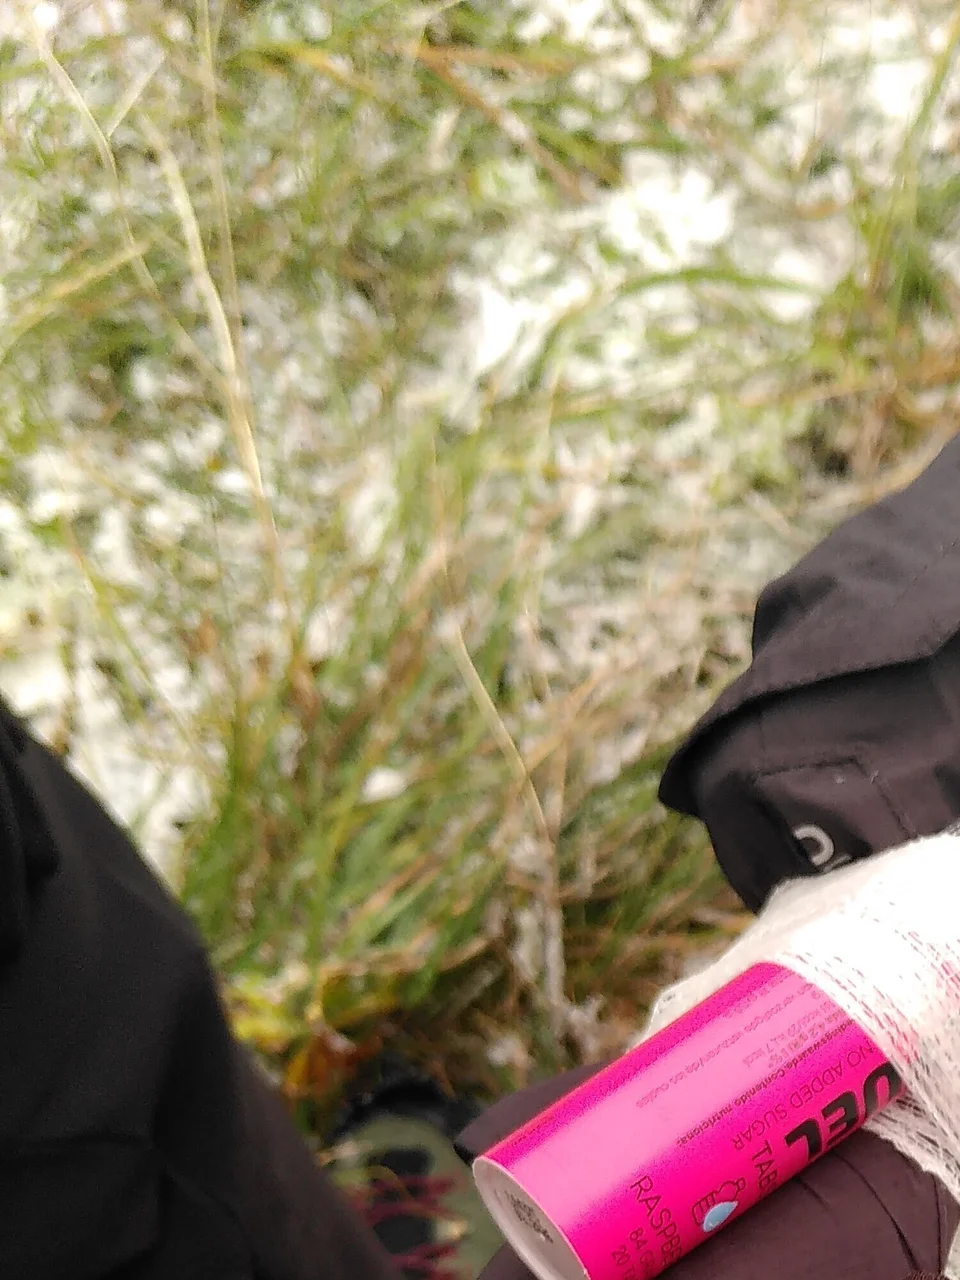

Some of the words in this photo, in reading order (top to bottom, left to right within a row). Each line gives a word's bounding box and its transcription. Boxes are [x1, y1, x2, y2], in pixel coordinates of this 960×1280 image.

[789, 1061, 843, 1109] ADDED
[731, 1103, 788, 1151] SUGAR
[612, 1244, 630, 1266] 20
[629, 1227, 649, 1251] 84
